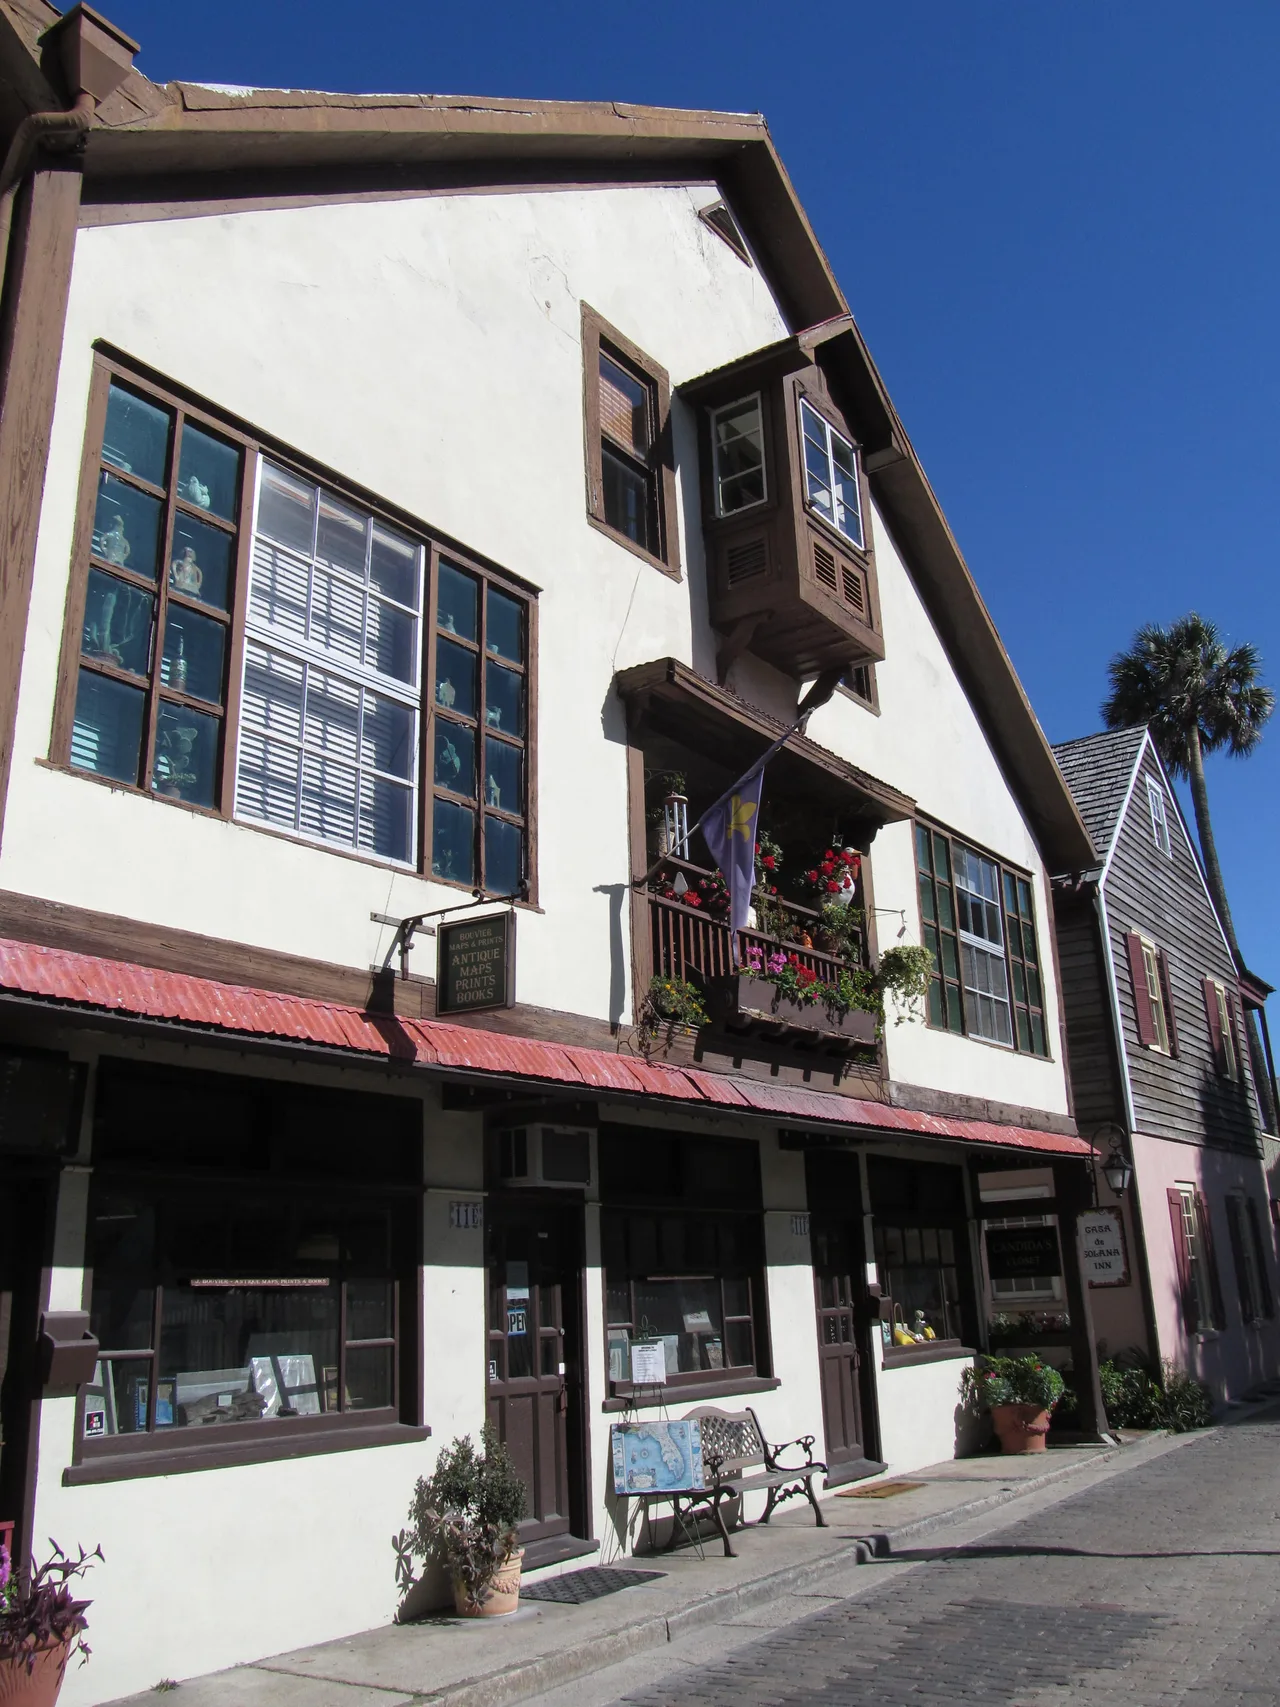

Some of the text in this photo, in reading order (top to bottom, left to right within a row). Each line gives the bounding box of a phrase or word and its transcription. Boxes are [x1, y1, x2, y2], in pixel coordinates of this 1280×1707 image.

[460, 928, 492, 941] BOUVIER
[449, 943, 469, 951] MAPS
[478, 936, 503, 946] PRINTS
[452, 948, 500, 965] ANTIQUE
[459, 963, 492, 976] MAPS
[455, 975, 495, 990] PRINTS
[457, 988, 493, 1003] BOOKS
[1085, 1225, 1112, 1233] CASA
[993, 1240, 1052, 1254] CANDIDA'S
[1083, 1248, 1120, 1258] SOLANA
[507, 1312, 527, 1333] PEN
